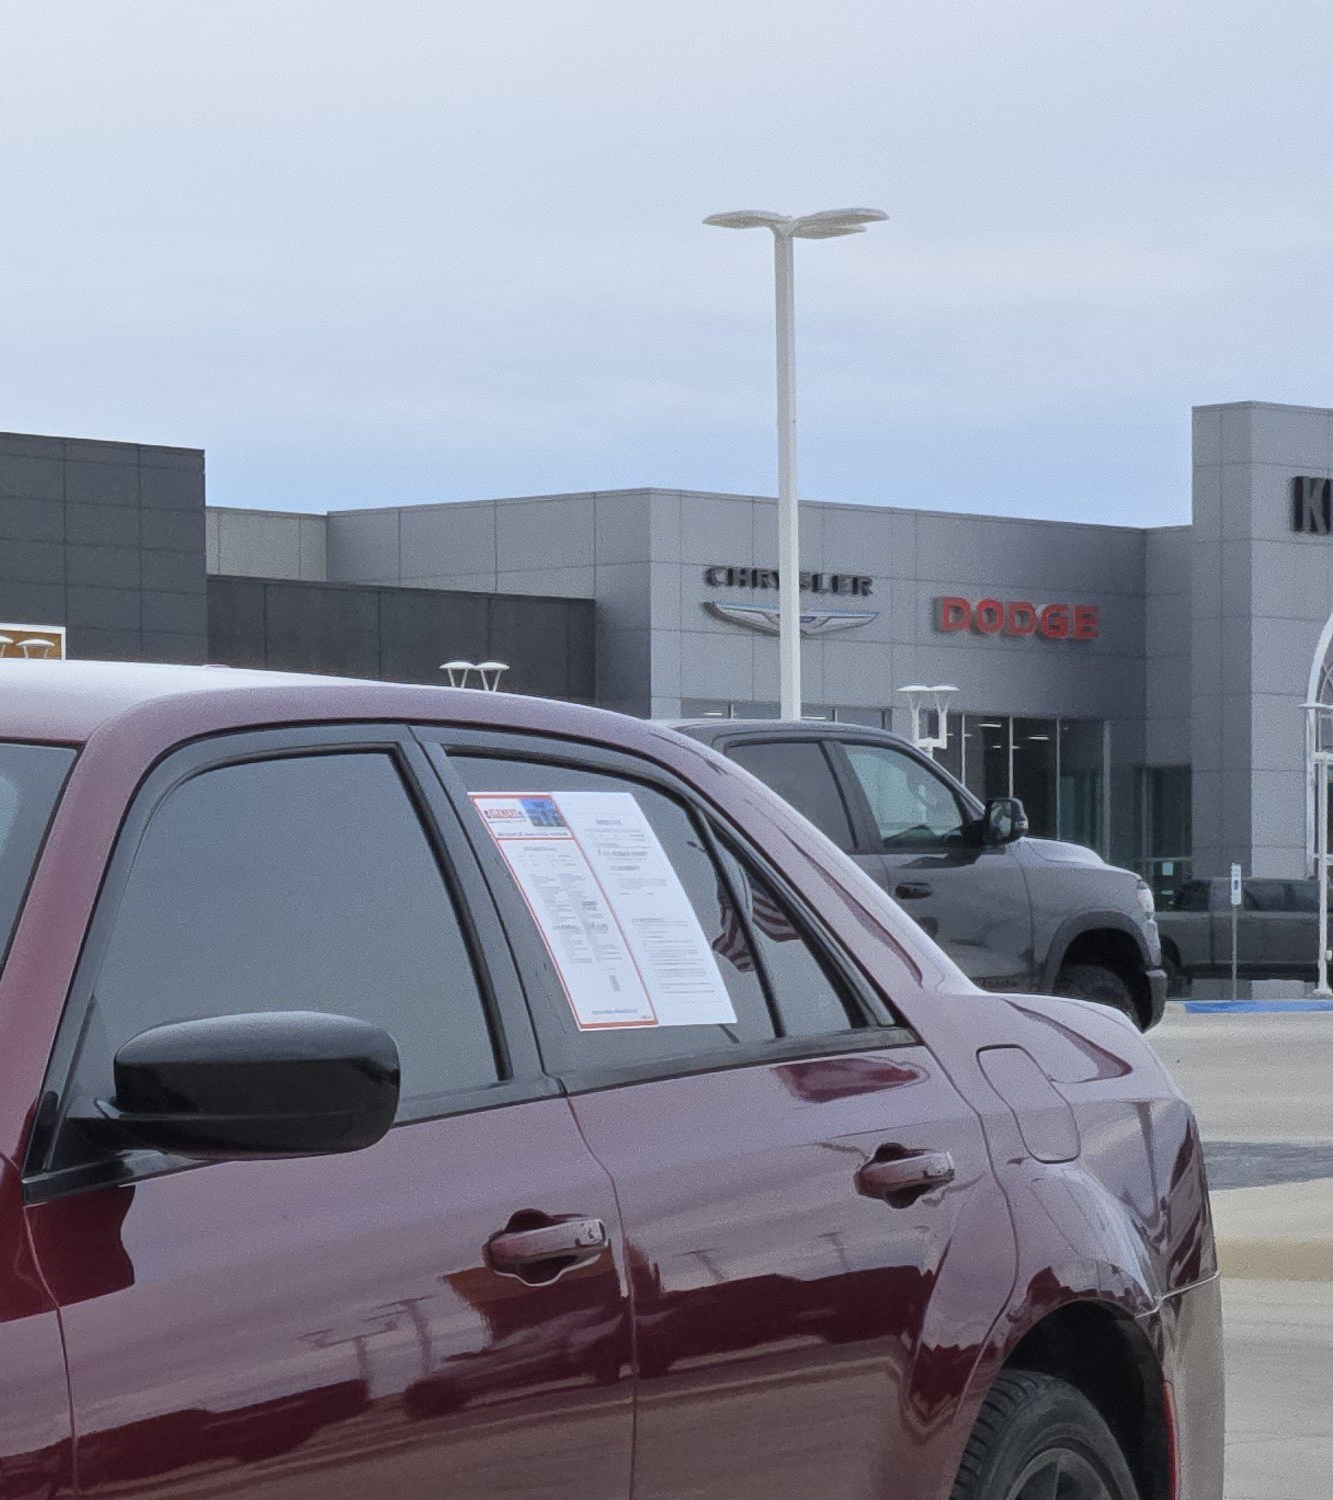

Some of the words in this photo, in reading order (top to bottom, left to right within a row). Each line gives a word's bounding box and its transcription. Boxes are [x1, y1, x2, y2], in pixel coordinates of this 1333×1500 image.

[1290, 475, 1333, 535] K
[704, 566, 874, 597] CHRSLER
[934, 597, 1101, 640] DODGE
